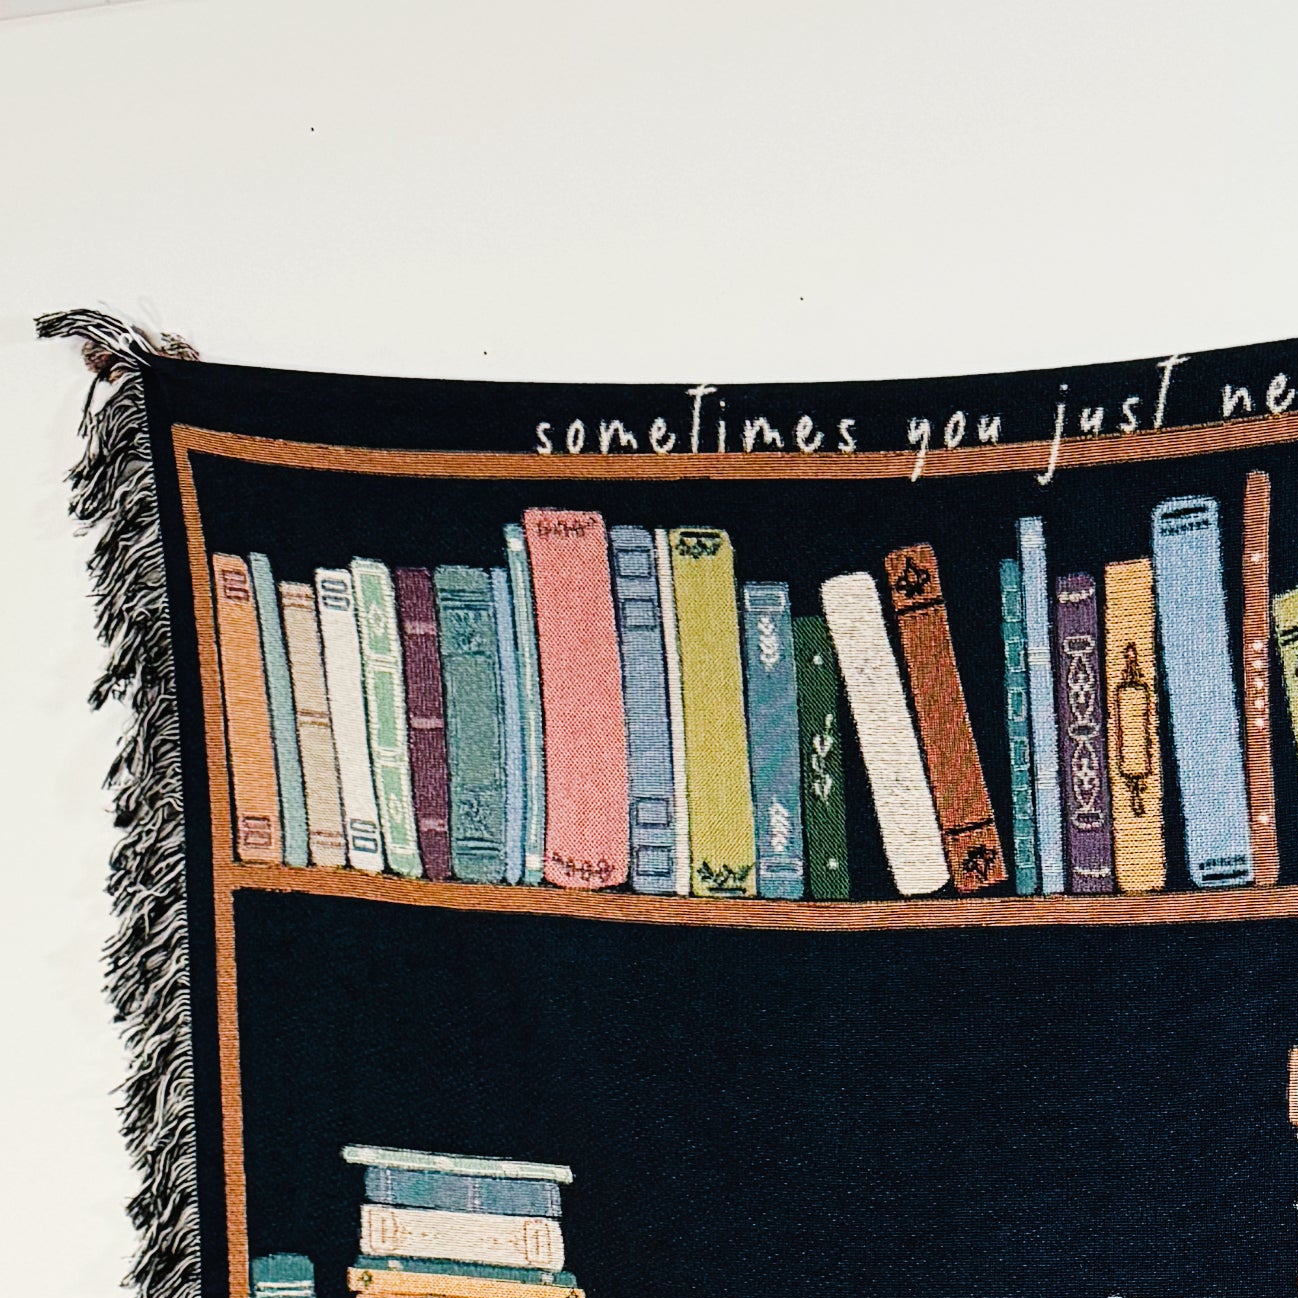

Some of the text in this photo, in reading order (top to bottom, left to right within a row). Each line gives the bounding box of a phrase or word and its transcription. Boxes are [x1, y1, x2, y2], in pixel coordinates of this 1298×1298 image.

[534, 383, 859, 456] sometimes
[907, 411, 1001, 482] you
[1035, 353, 1188, 487] just
